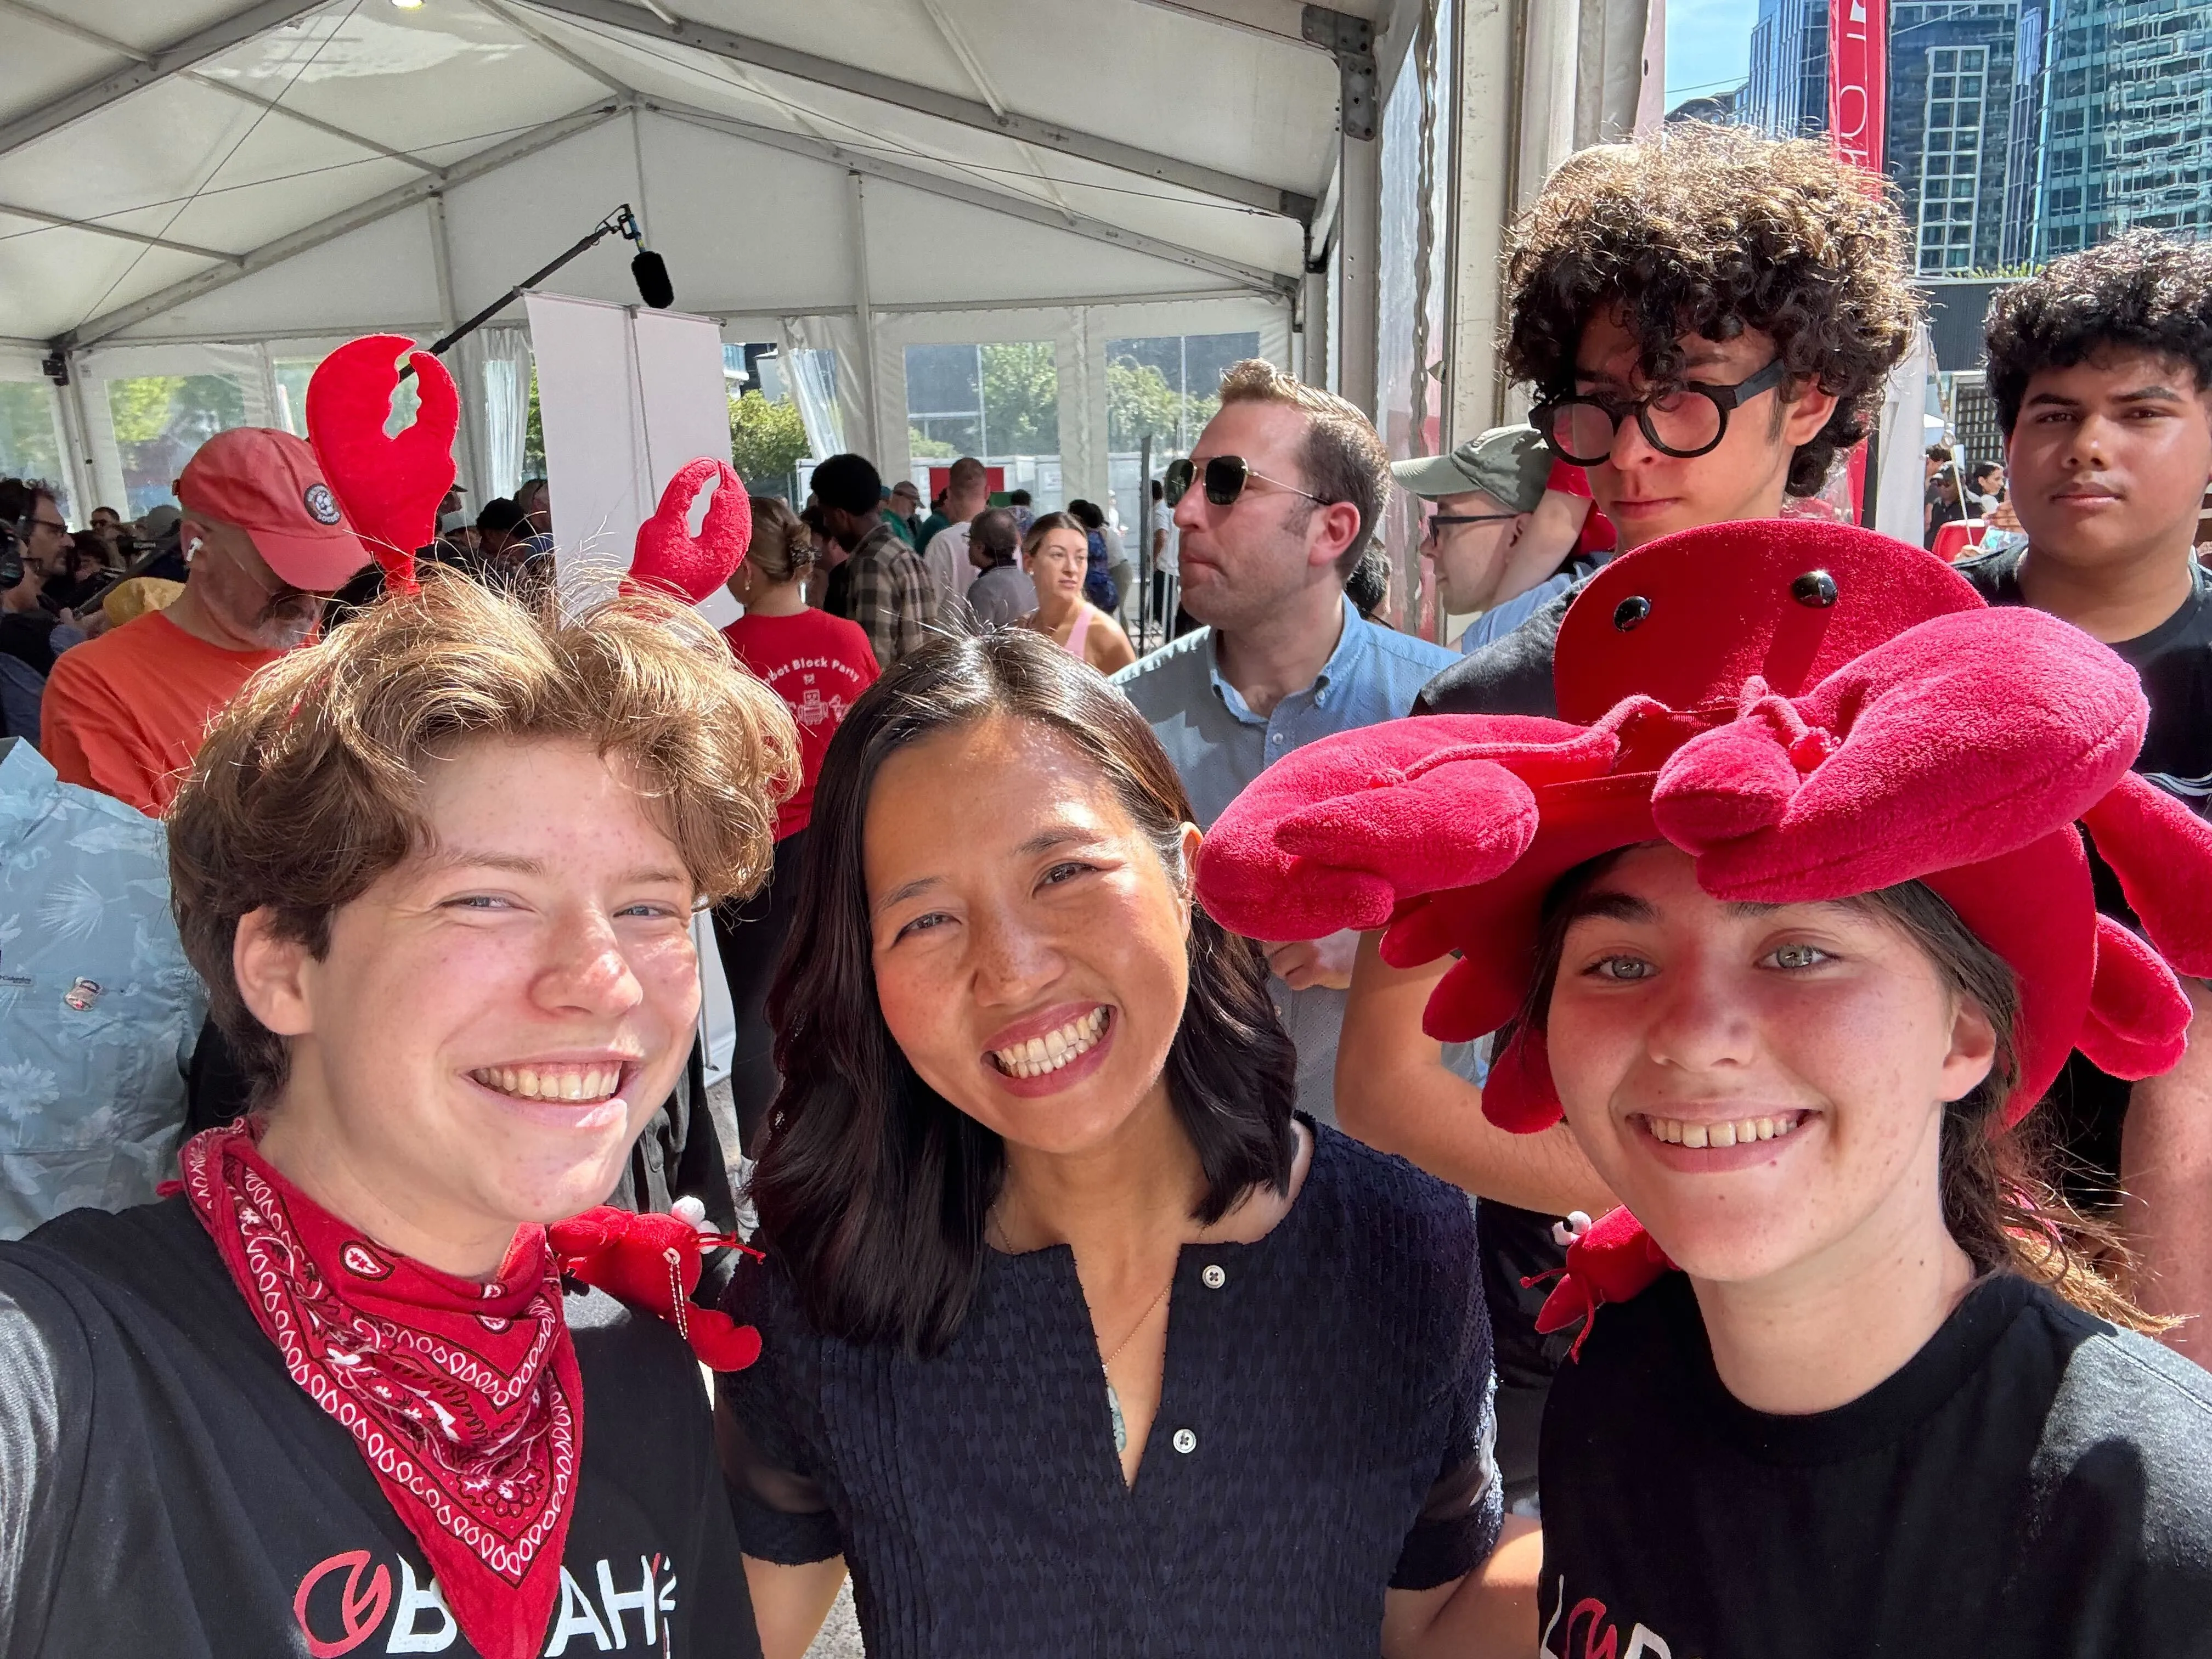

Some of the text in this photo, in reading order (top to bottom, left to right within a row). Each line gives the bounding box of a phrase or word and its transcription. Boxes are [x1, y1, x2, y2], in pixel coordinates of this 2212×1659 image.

[764, 656, 860, 684] obot Block Party
